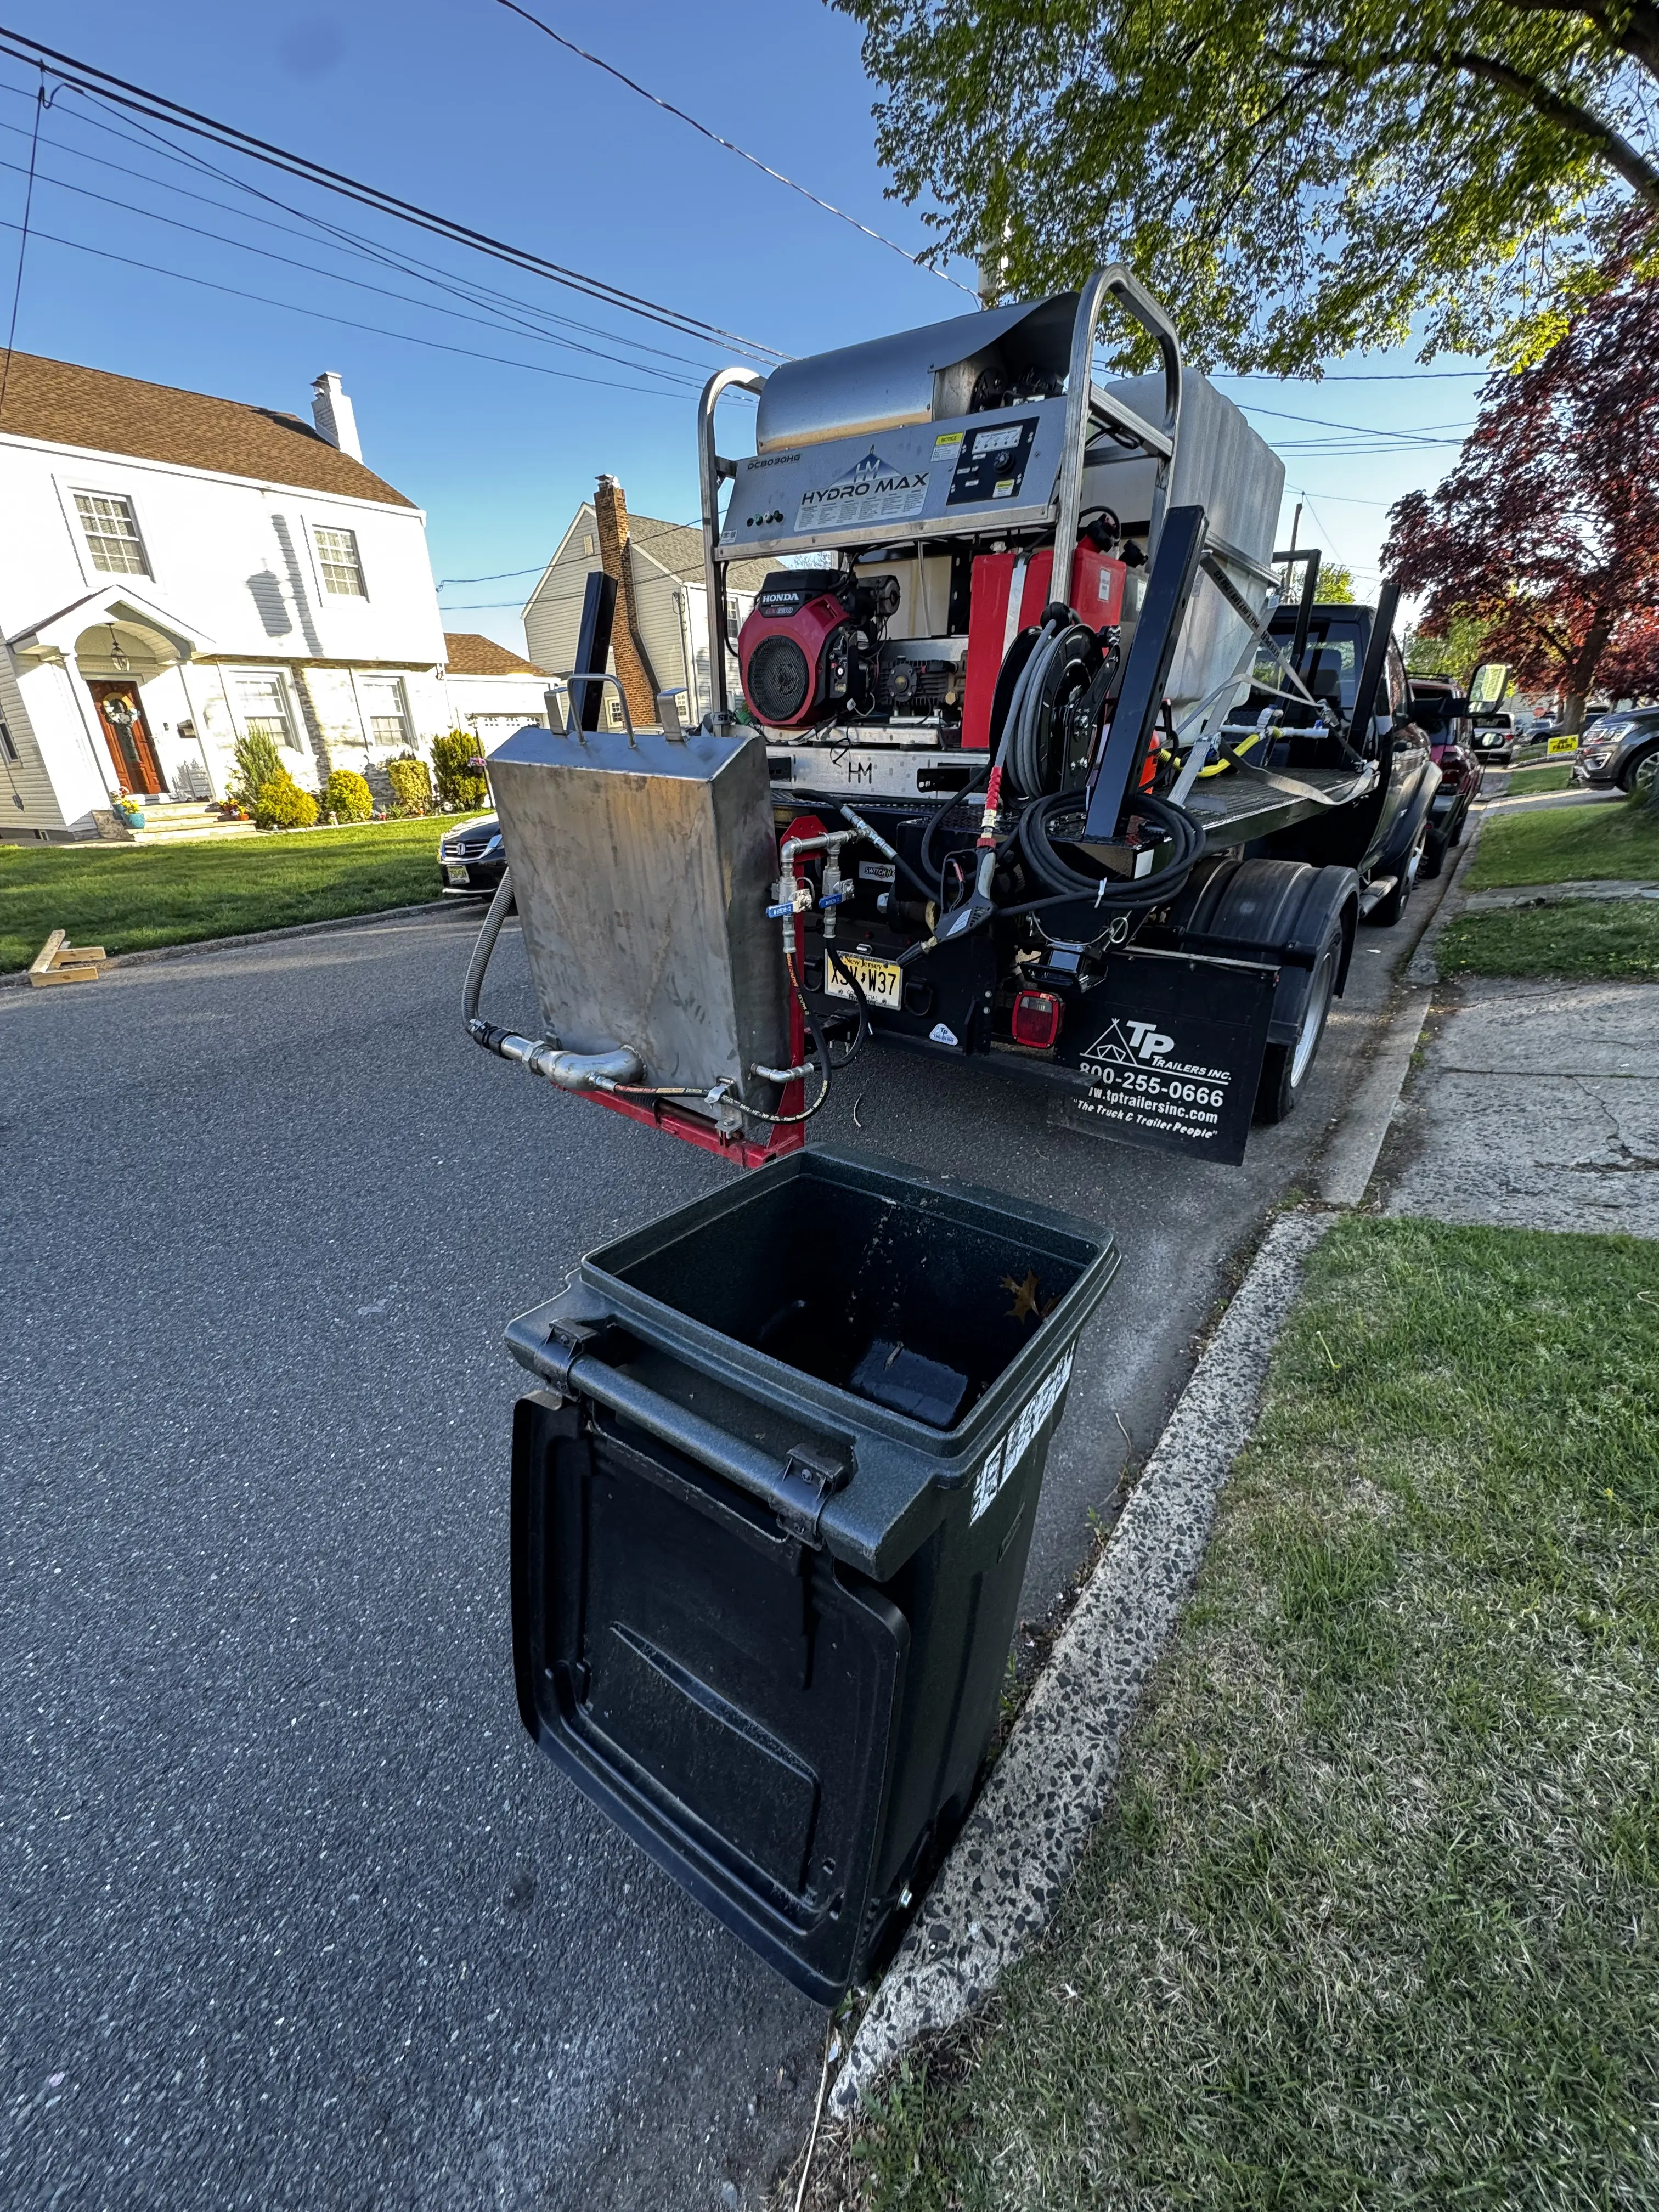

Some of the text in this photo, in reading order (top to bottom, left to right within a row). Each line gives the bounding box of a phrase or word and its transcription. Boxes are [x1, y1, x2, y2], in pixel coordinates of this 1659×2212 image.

[802, 472, 929, 505] HYDRO MAX
[762, 593, 799, 603] HONDA
[848, 761, 872, 784] HM
[865, 867, 886, 877] SWITCH
[868, 969, 896, 996] W37
[1126, 1020, 1175, 1059] TP
[1152, 1055, 1232, 1080] TRAILERS INC.
[1079, 1062, 1224, 1107] 800-255-0666
[1073, 1098, 1218, 1138] "The Truck & Trailer People"
